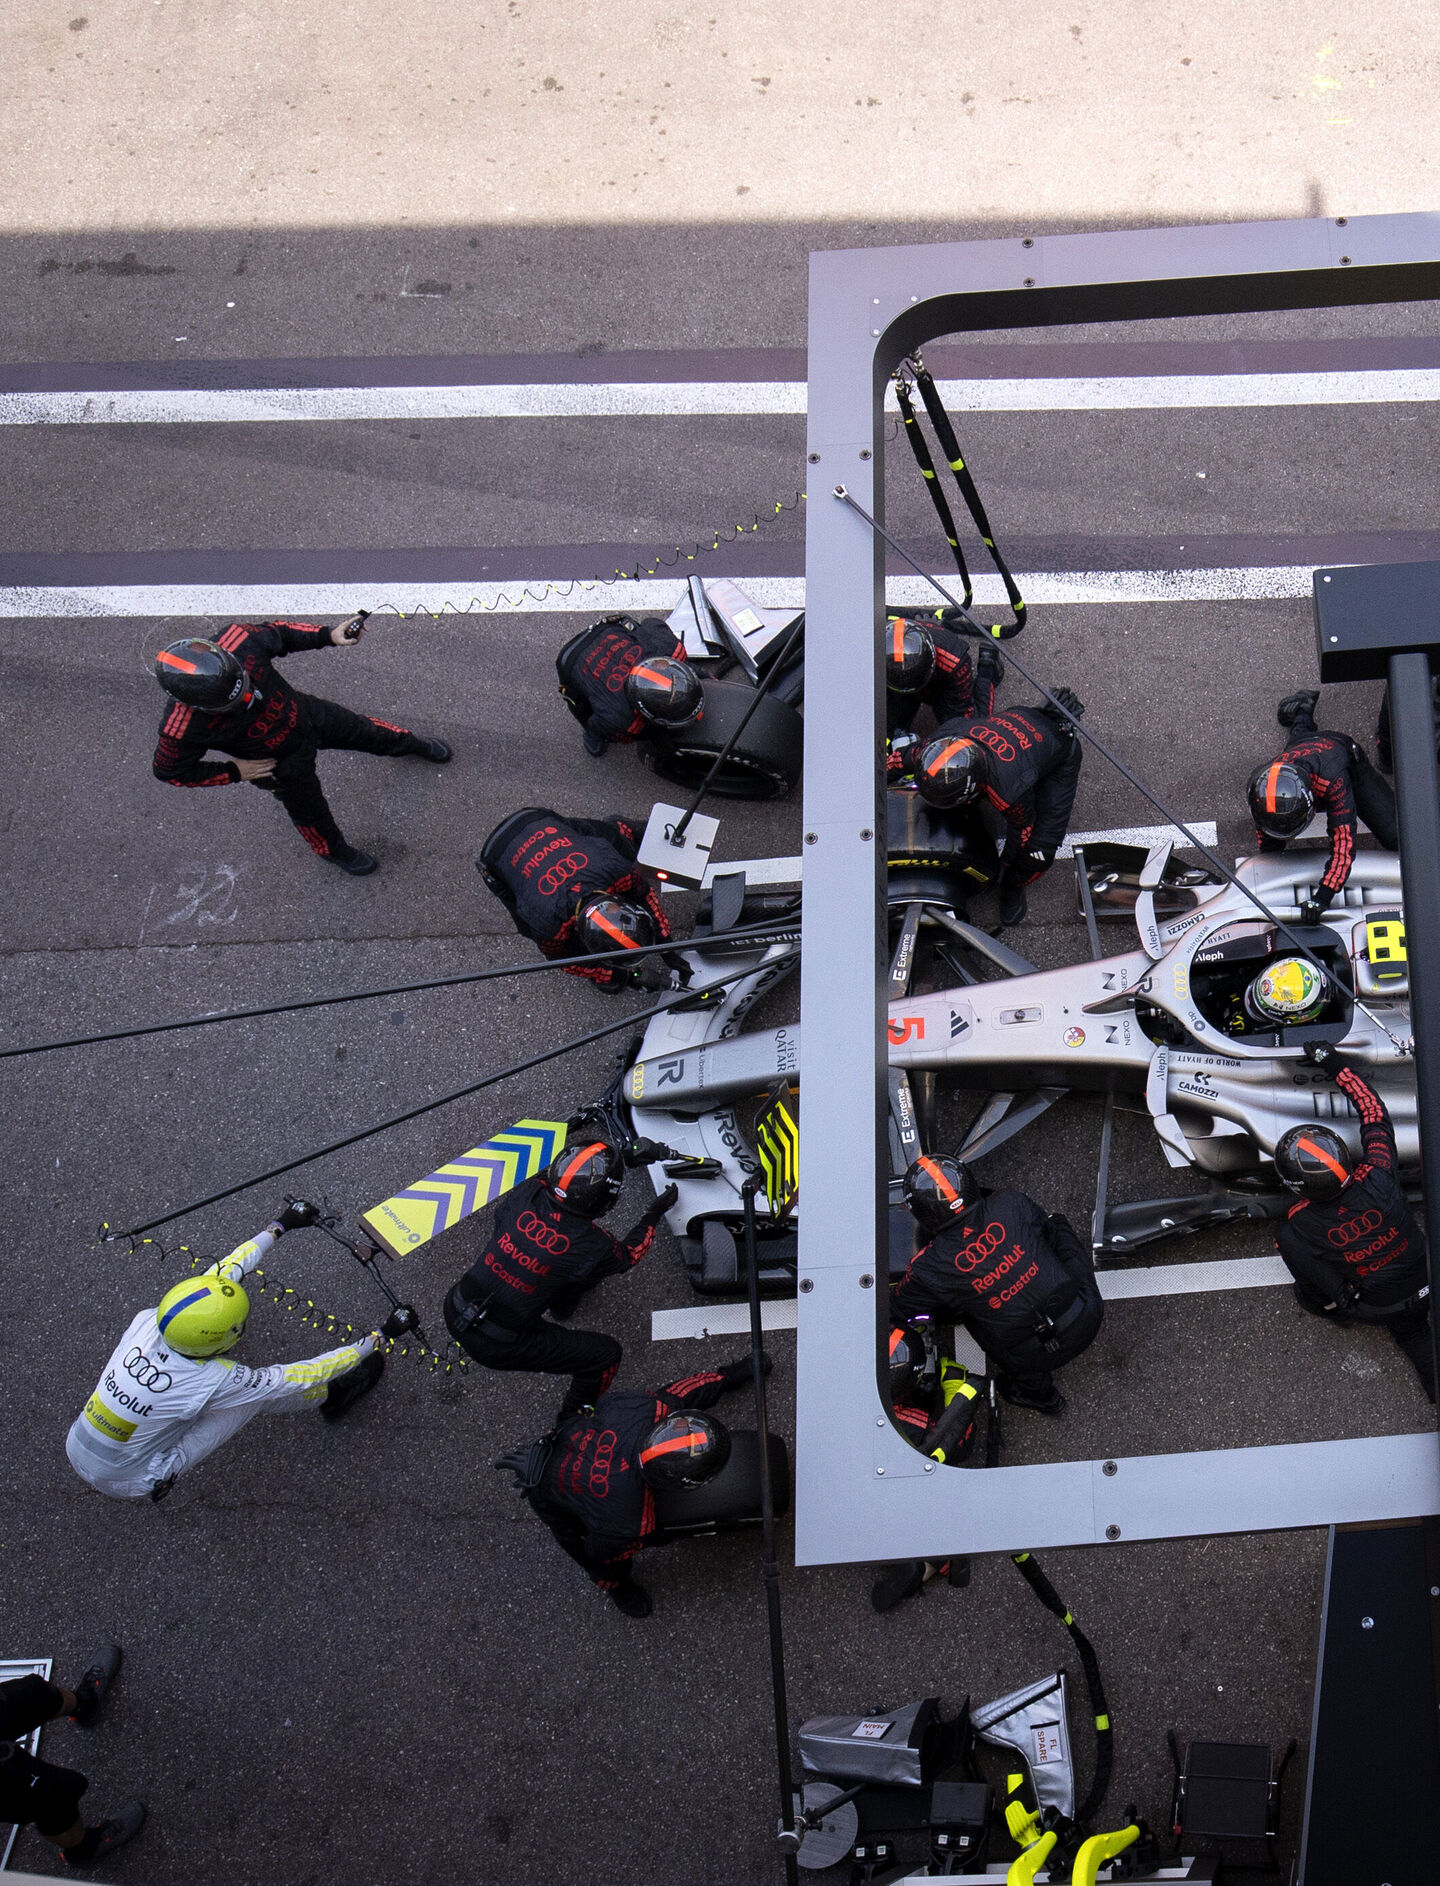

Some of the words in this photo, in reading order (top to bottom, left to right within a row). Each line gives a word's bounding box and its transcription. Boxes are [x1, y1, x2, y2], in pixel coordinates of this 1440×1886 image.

[521, 836, 573, 879] Revolut
[1147, 925, 1159, 951] Aleph
[1167, 913, 1206, 935] CAMOZZI
[897, 933, 911, 968] Extreme
[1195, 950, 1224, 962] Aleph
[888, 1017, 925, 1045] 5
[1123, 1020, 1131, 1046] NEXO
[774, 1029, 788, 1073] QATAR
[787, 1040, 798, 1070] visit
[1156, 1052, 1167, 1081] Aleph
[1177, 1056, 1202, 1065] HYATT
[1216, 1058, 1241, 1067] WORLD
[1178, 1081, 1219, 1098] CAMOZZI
[897, 1088, 911, 1128] Extreme
[714, 1110, 762, 1175] Revo
[497, 1232, 551, 1277] Revolut
[1343, 1226, 1400, 1263] Revolut
[971, 1243, 1026, 1294] Revolut
[1000, 1262, 1039, 1302] Castrol
[103, 1369, 154, 1417] Revolut
[1037, 1730, 1047, 1762] SPARE
[1049, 1738, 1057, 1750] FL
